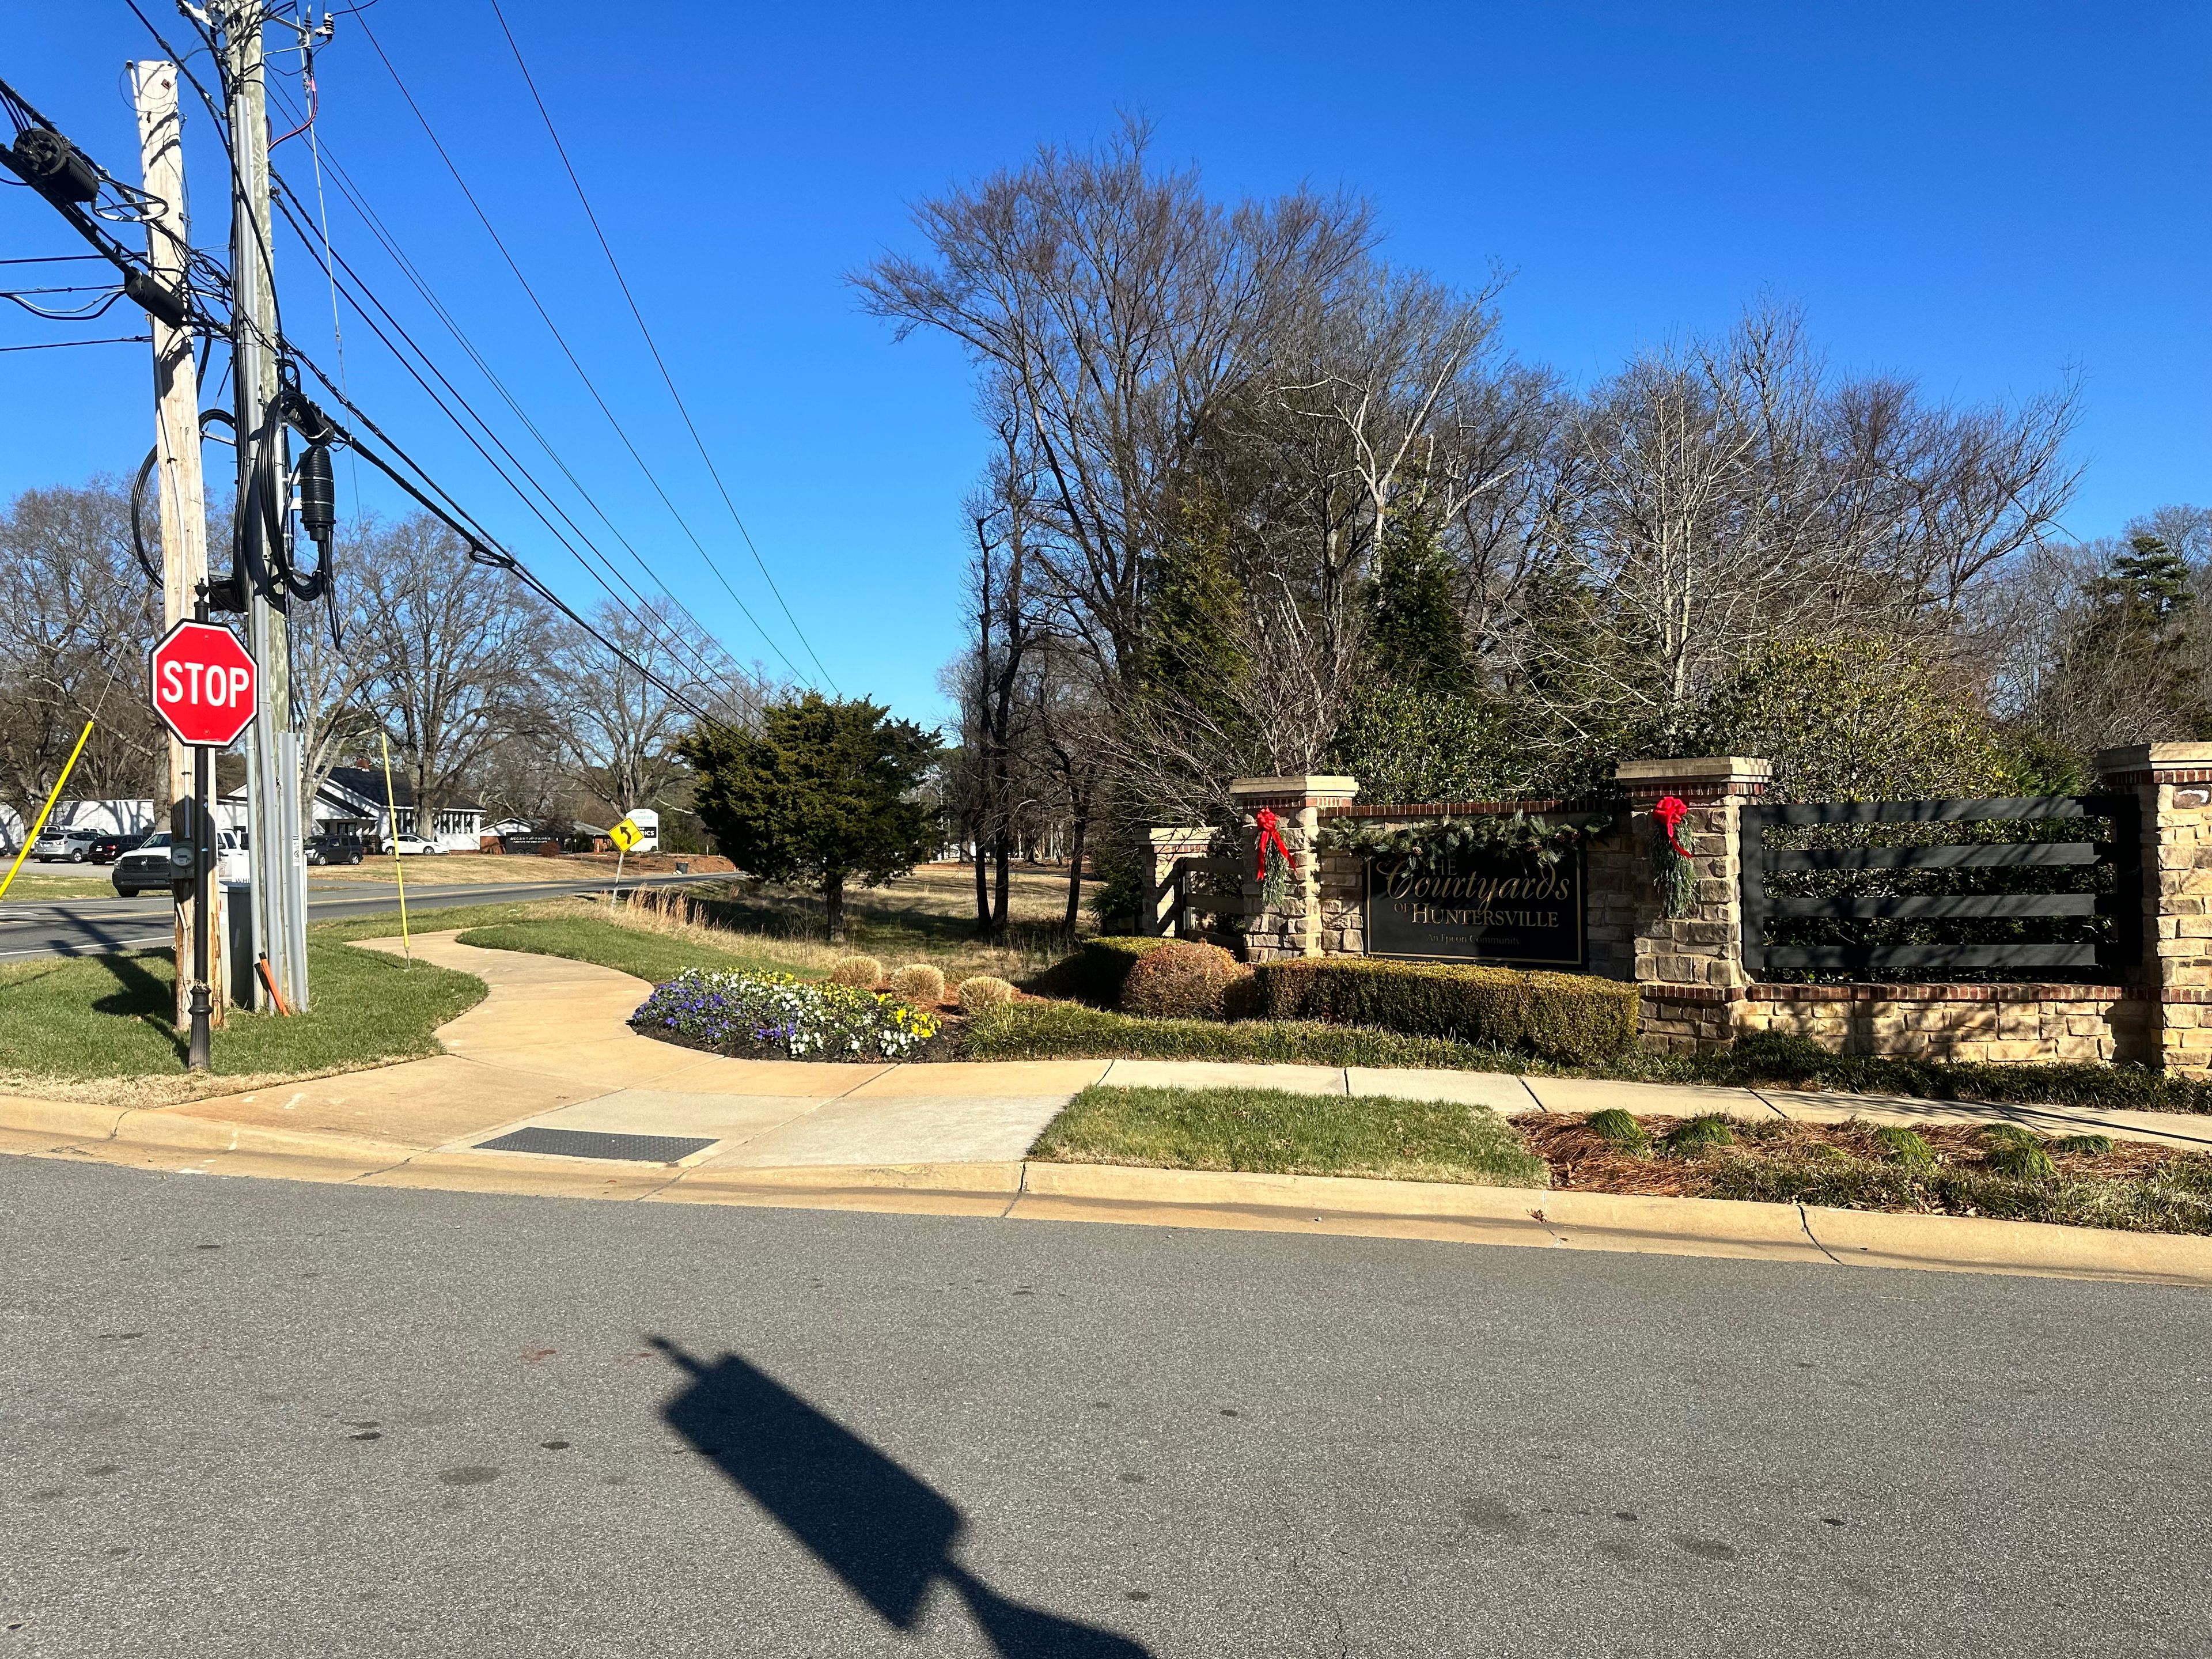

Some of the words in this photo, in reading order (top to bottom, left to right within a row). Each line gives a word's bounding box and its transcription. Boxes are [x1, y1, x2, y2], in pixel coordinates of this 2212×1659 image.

[162, 660, 250, 708] STOP
[1376, 860, 1570, 915] Courtyards
[1394, 902, 1410, 912] OF
[1411, 903, 1559, 927] HUNTERSVILLE
